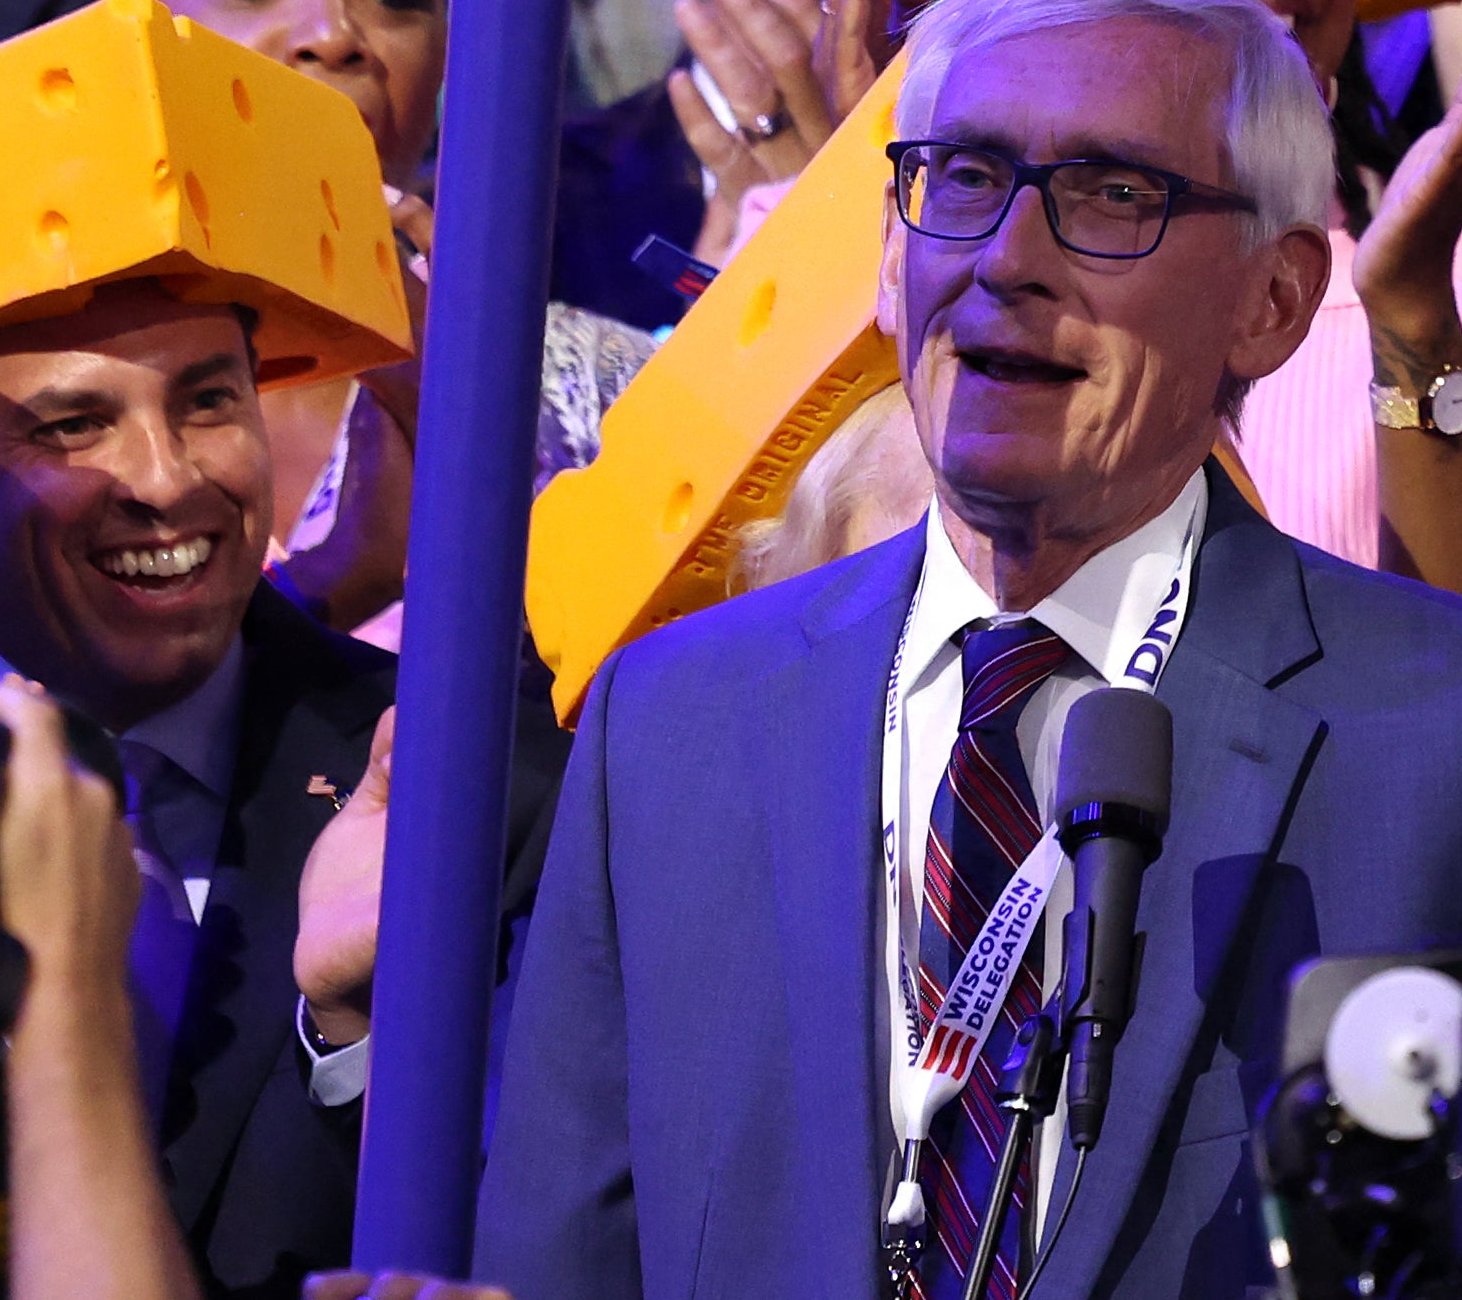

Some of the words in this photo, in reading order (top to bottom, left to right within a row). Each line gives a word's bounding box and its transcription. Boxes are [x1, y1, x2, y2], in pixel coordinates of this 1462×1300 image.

[737, 369, 865, 504] ORIGINAL
[944, 877, 1032, 1021] WISCONSIN
[966, 886, 1044, 1032] DELEGATION
